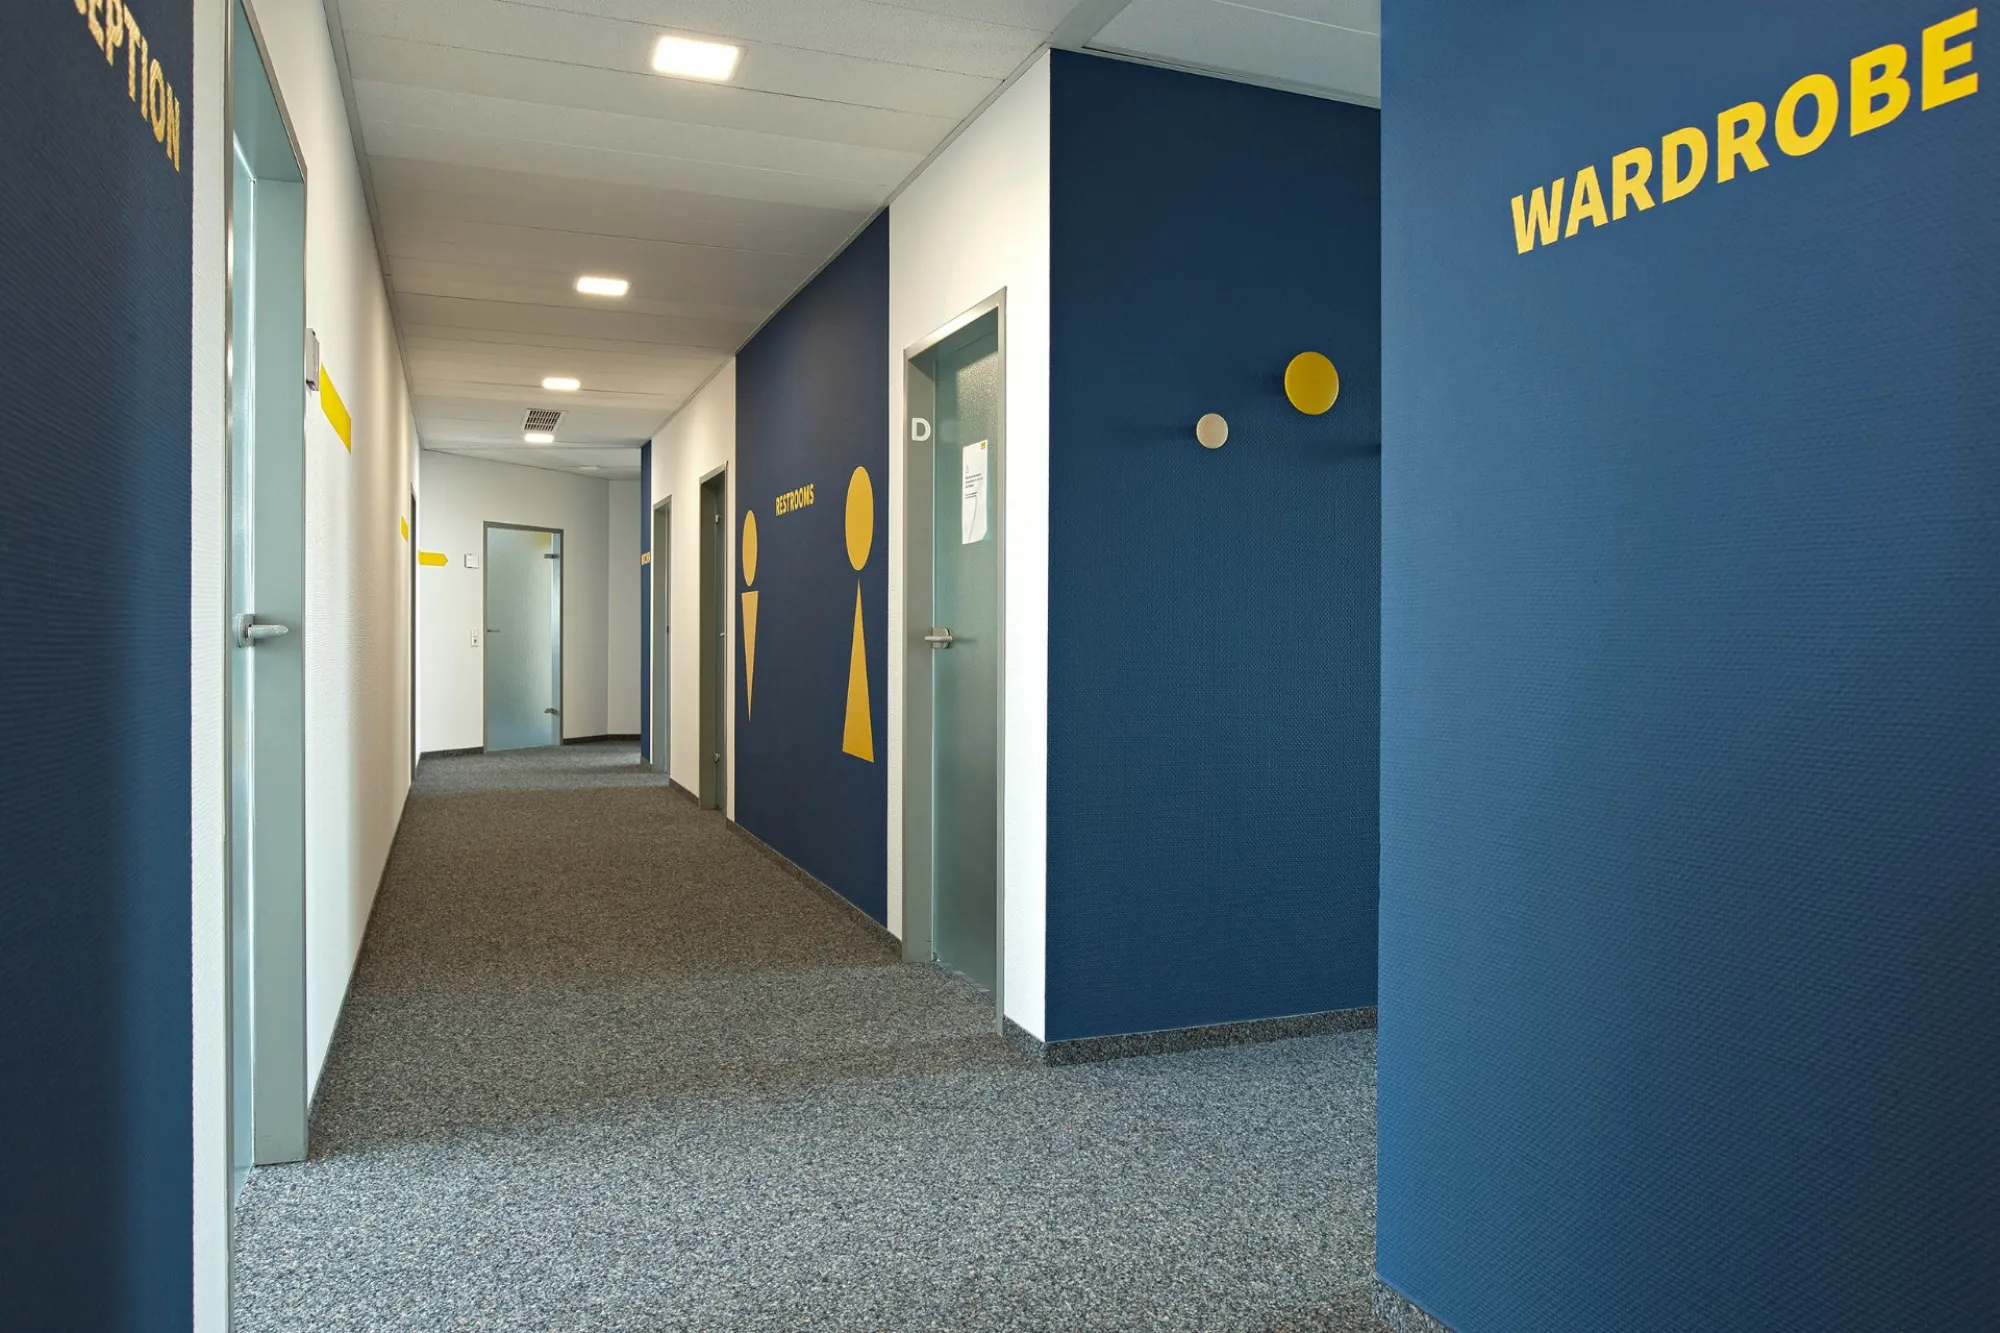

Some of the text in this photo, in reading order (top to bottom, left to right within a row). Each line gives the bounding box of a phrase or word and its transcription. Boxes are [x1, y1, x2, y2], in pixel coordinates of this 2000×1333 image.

[73, 0, 180, 172] EPTION
[1511, 8, 1979, 254] WARDROBE
[911, 417, 932, 442] D
[775, 483, 815, 516] RESTROOMS
